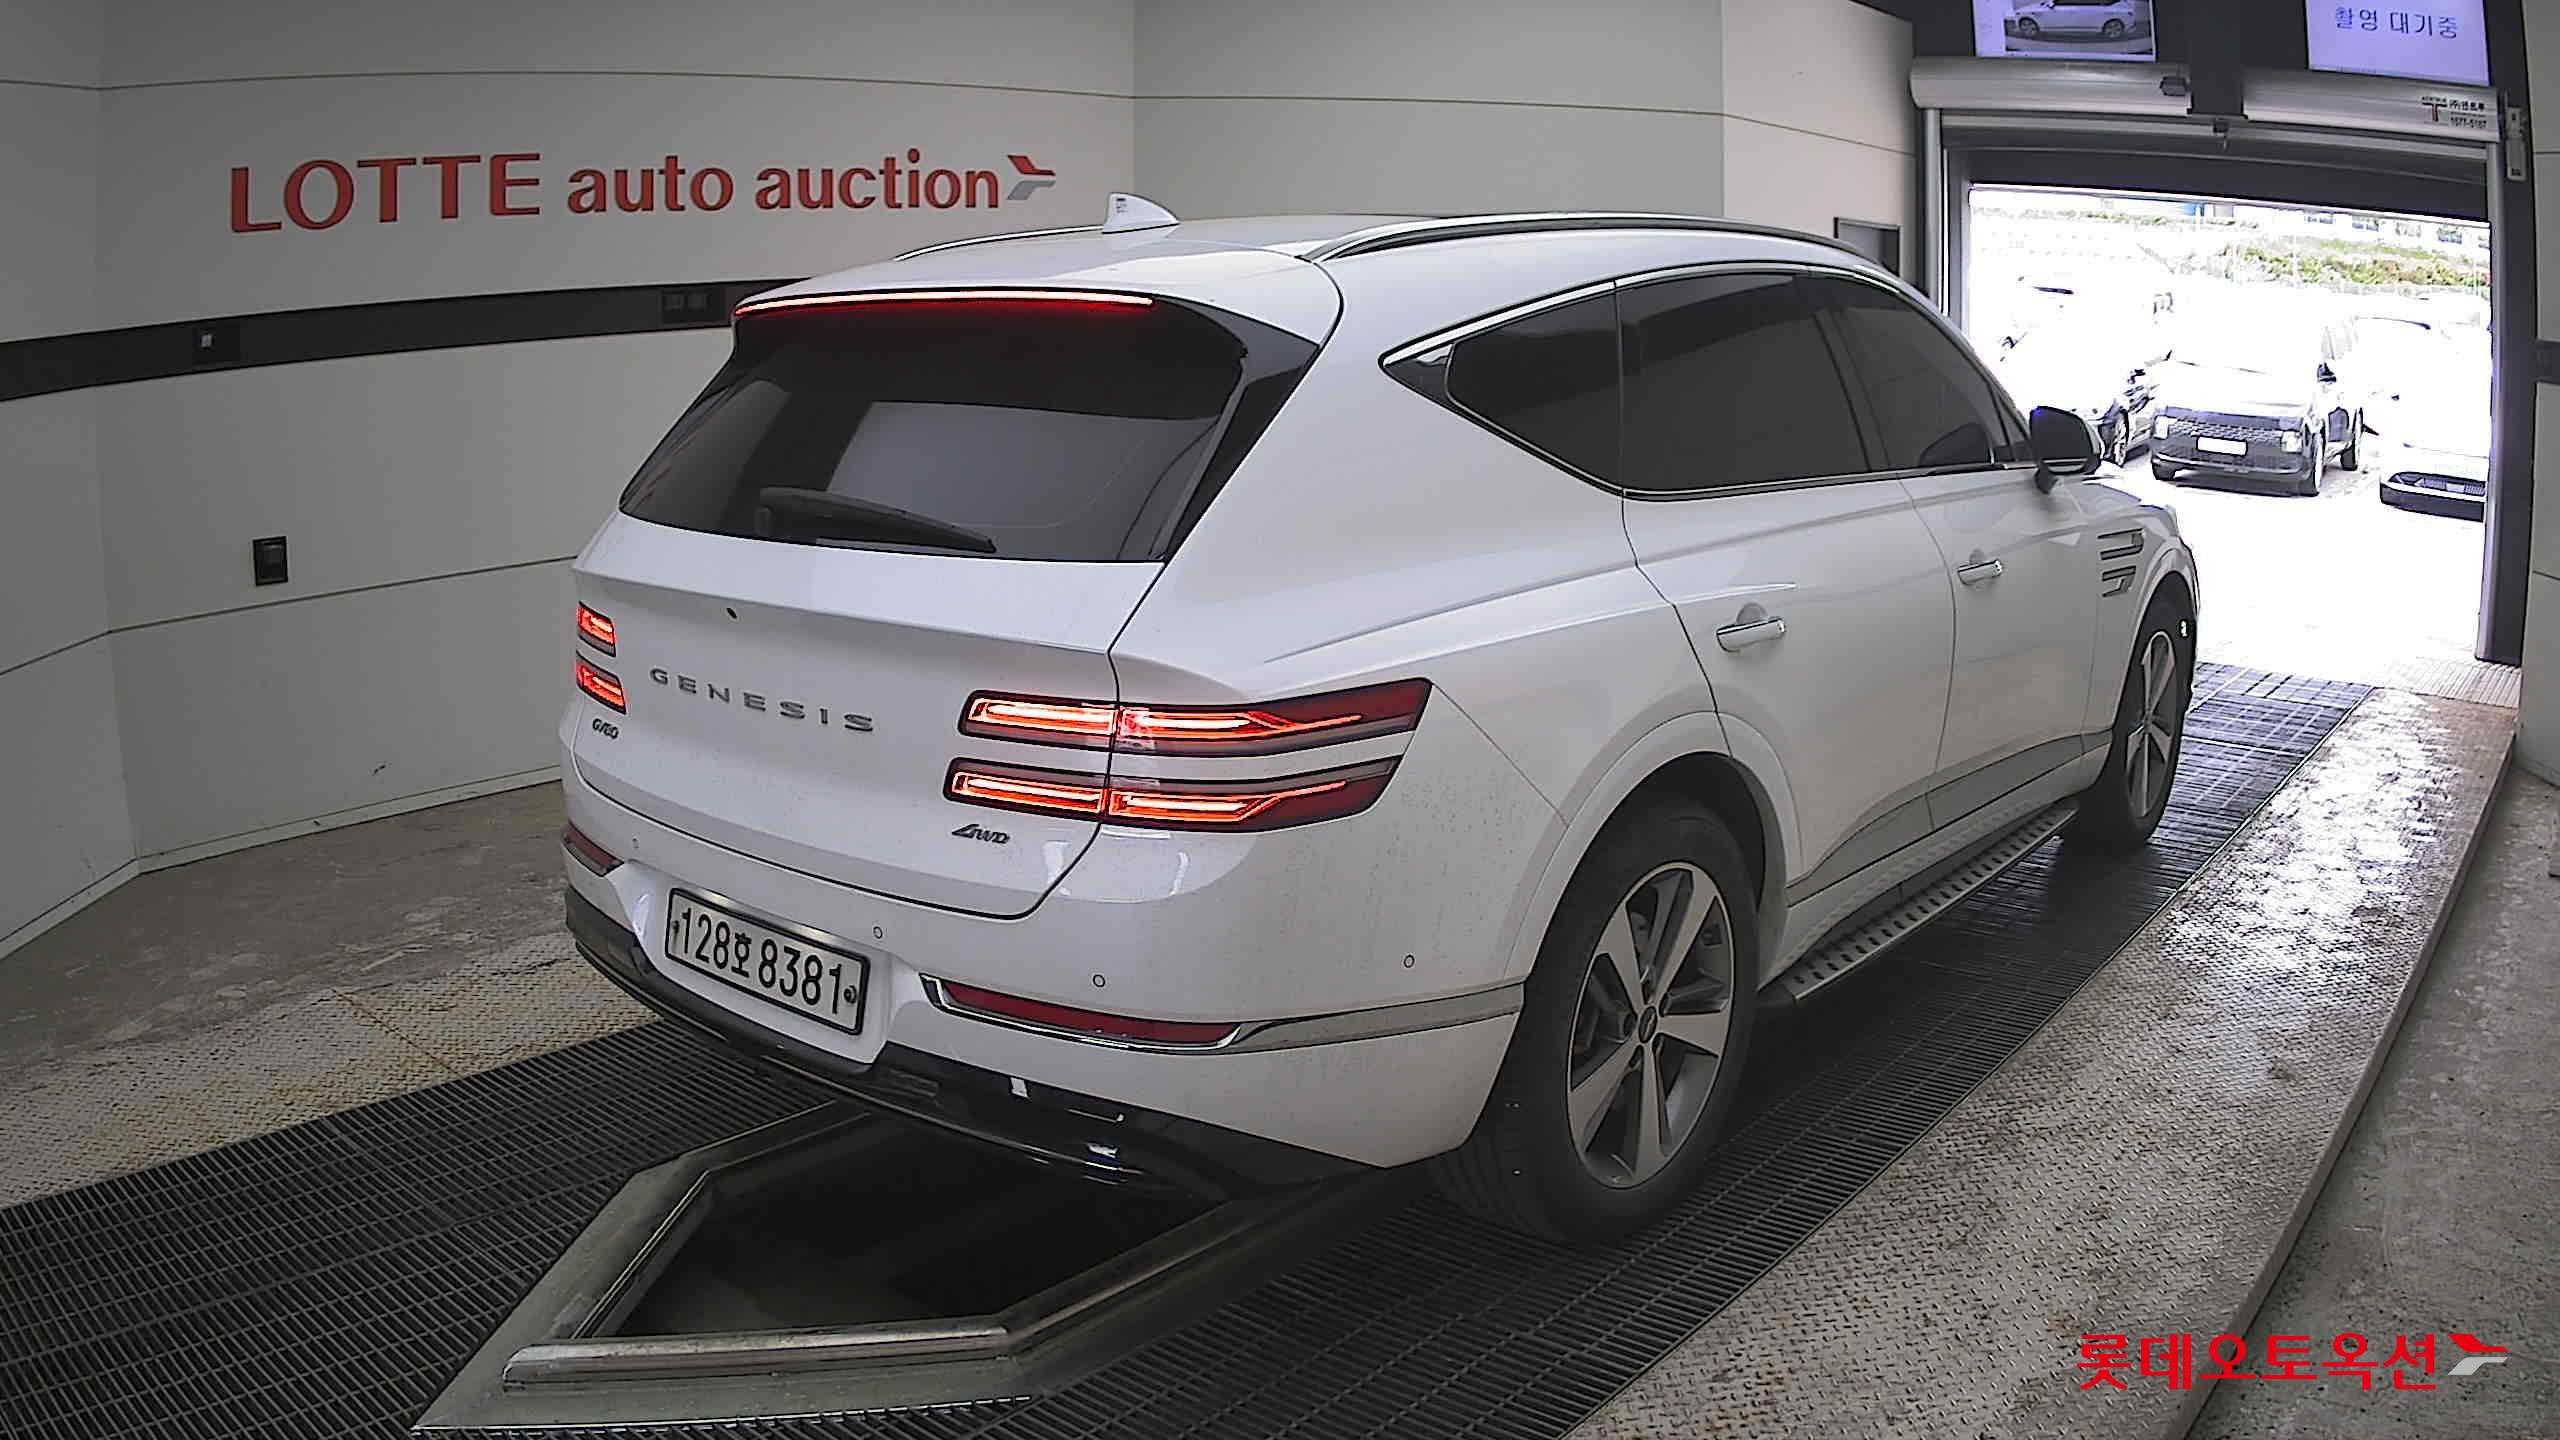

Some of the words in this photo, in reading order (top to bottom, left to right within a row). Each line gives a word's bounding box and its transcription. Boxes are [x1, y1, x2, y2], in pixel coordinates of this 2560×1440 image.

[2335, 7, 2378, 31] 촬영
[2390, 12, 2457, 39] 대기중
[231, 153, 540, 233] LOTTE
[568, 155, 735, 213] auto
[755, 149, 1000, 212] auction
[650, 668, 874, 732] GENESIS
